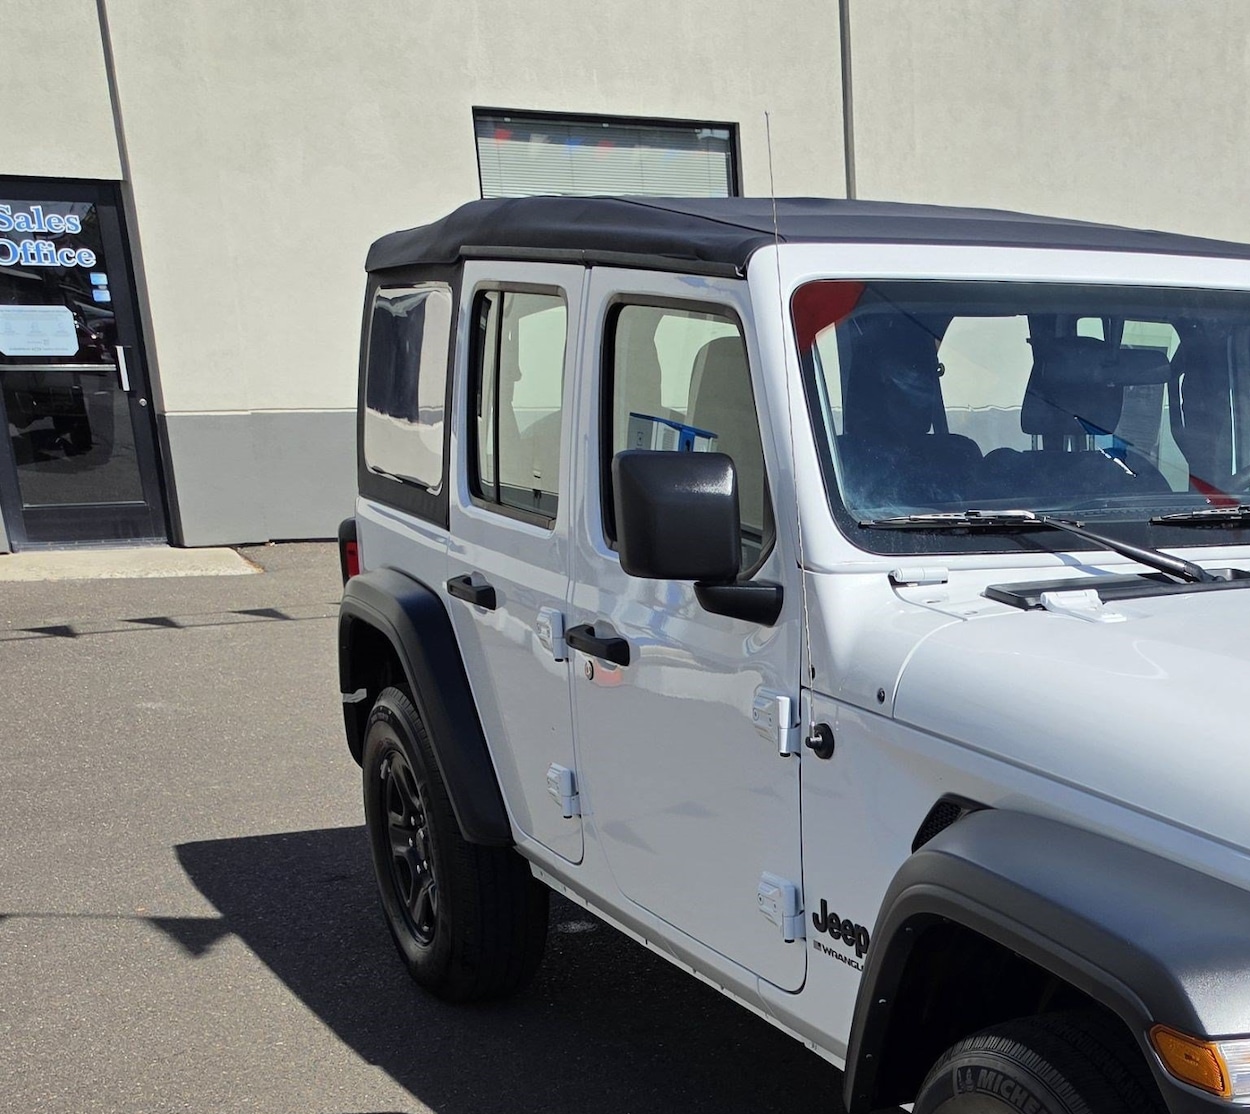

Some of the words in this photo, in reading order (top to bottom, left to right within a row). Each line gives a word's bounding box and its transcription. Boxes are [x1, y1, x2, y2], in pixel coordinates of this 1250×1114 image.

[0, 204, 82, 234] Sales
[0, 238, 96, 268] Office
[812, 898, 870, 959] Jeep
